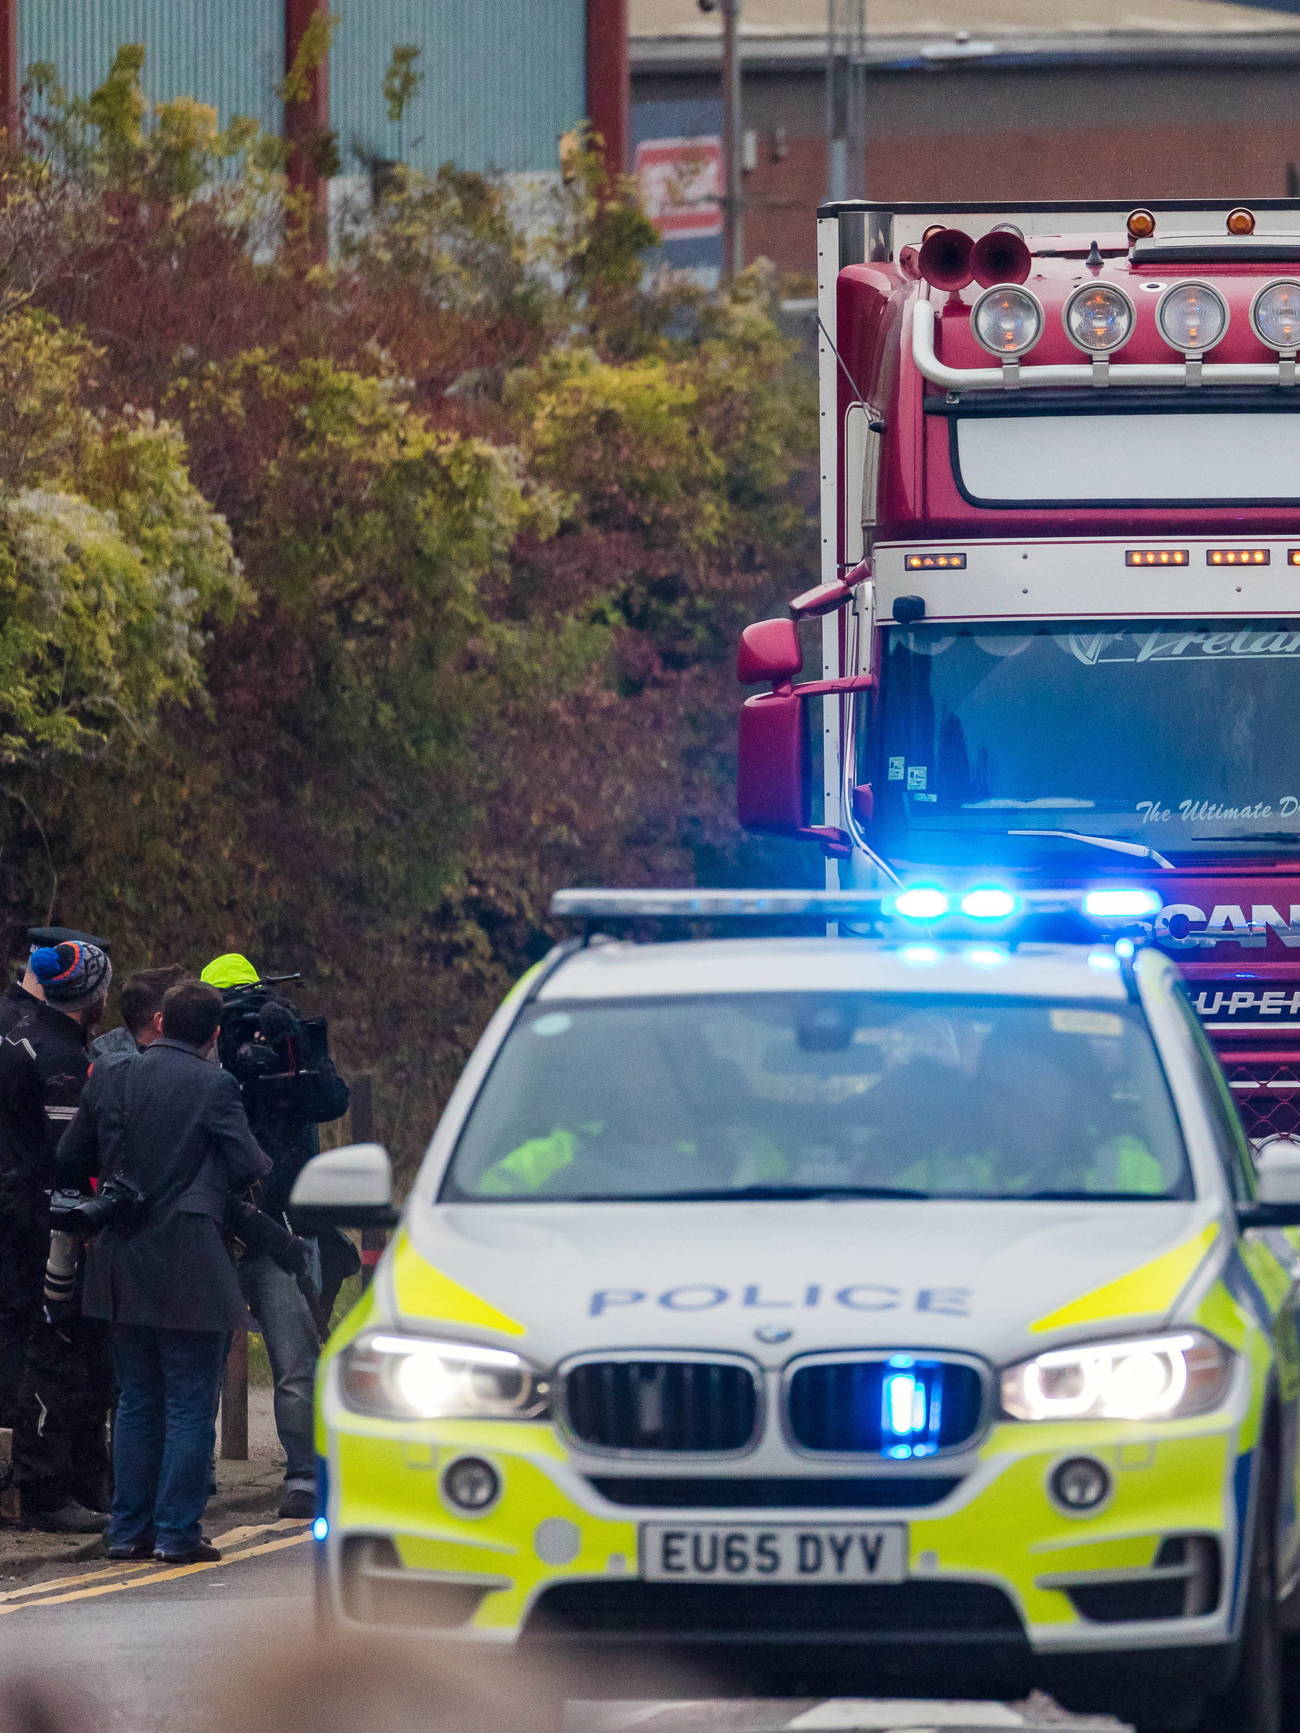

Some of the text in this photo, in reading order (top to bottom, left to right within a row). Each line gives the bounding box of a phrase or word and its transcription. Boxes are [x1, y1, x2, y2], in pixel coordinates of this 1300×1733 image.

[1135, 800, 1172, 824] The
[1178, 799, 1272, 822] Ultimate
[587, 1283, 972, 1318] POLICE
[661, 1531, 884, 1573] EU65 DYV
